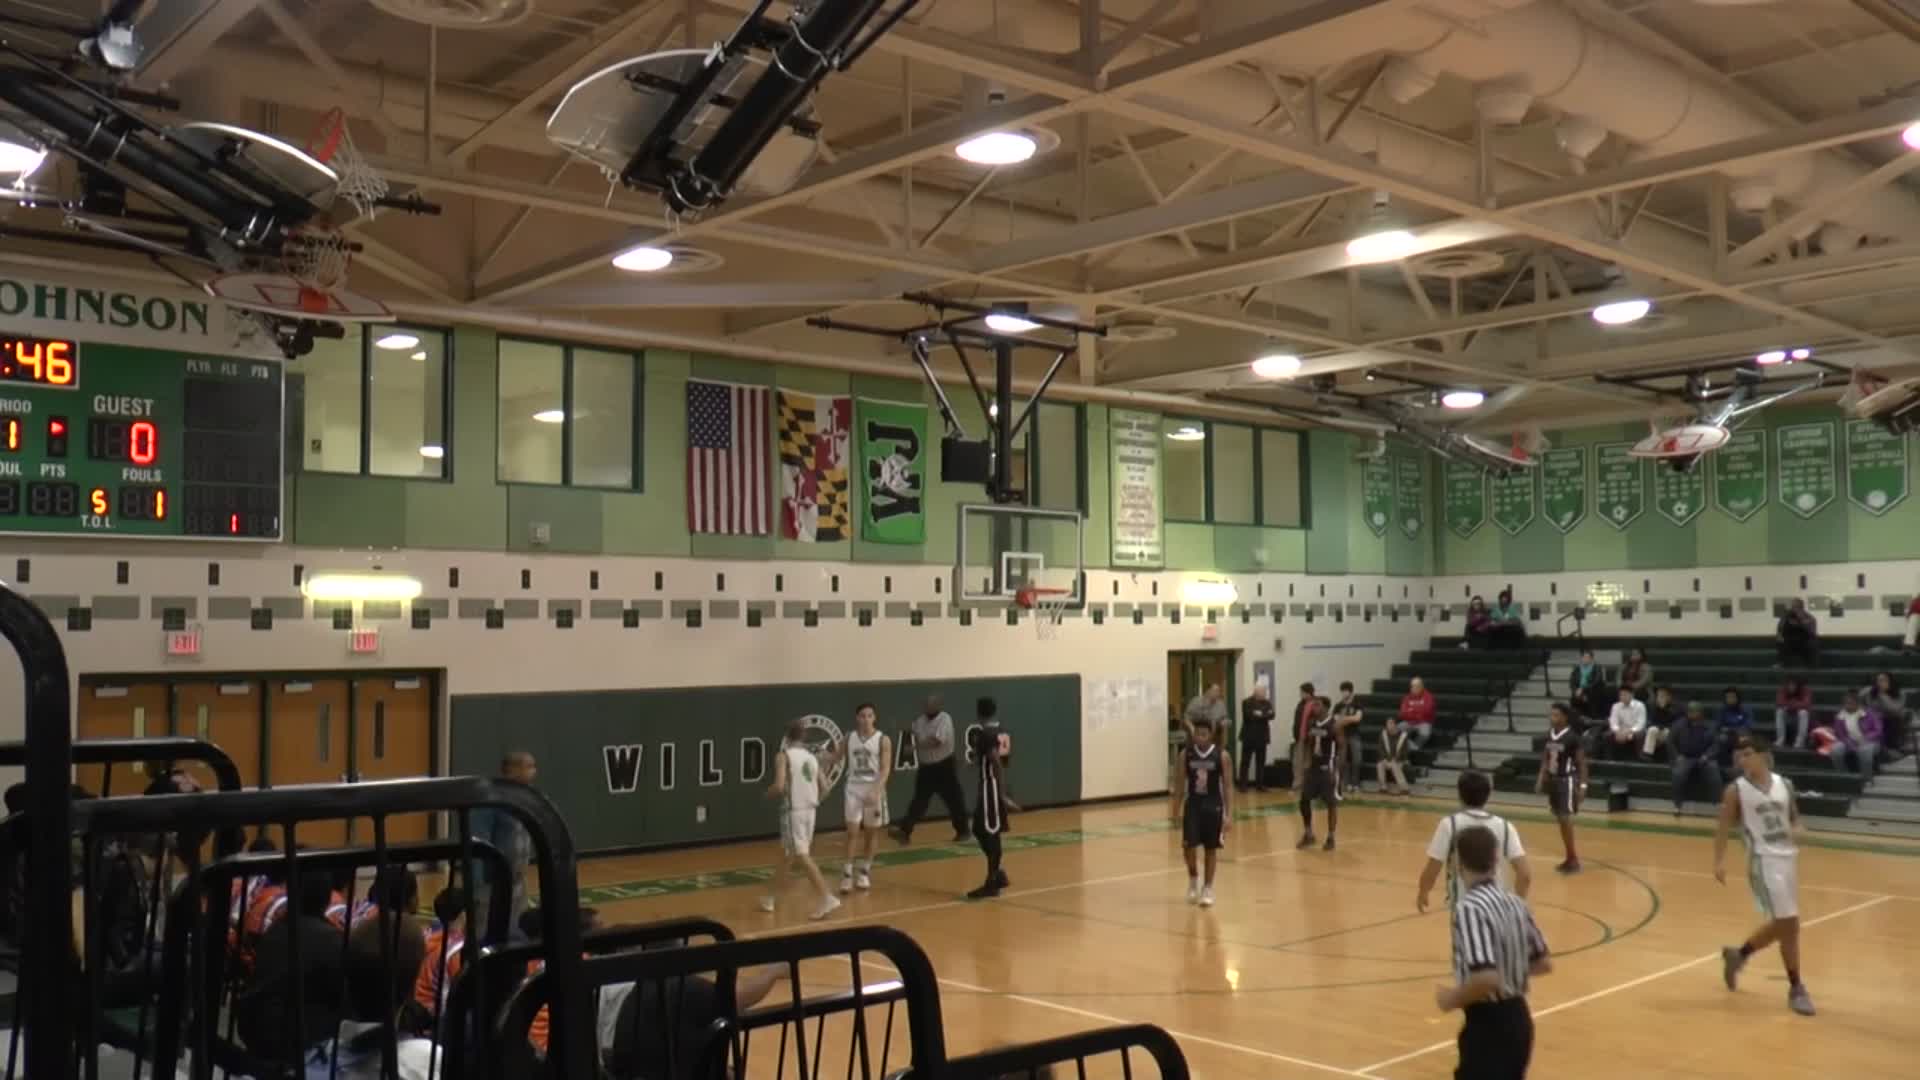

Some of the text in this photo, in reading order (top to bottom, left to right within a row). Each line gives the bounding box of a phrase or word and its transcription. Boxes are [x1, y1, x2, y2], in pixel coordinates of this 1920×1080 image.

[94, 395, 153, 416] GUEST
[131, 422, 155, 463] 0
[40, 463, 66, 478] PTS
[122, 468, 162, 482] FOULS
